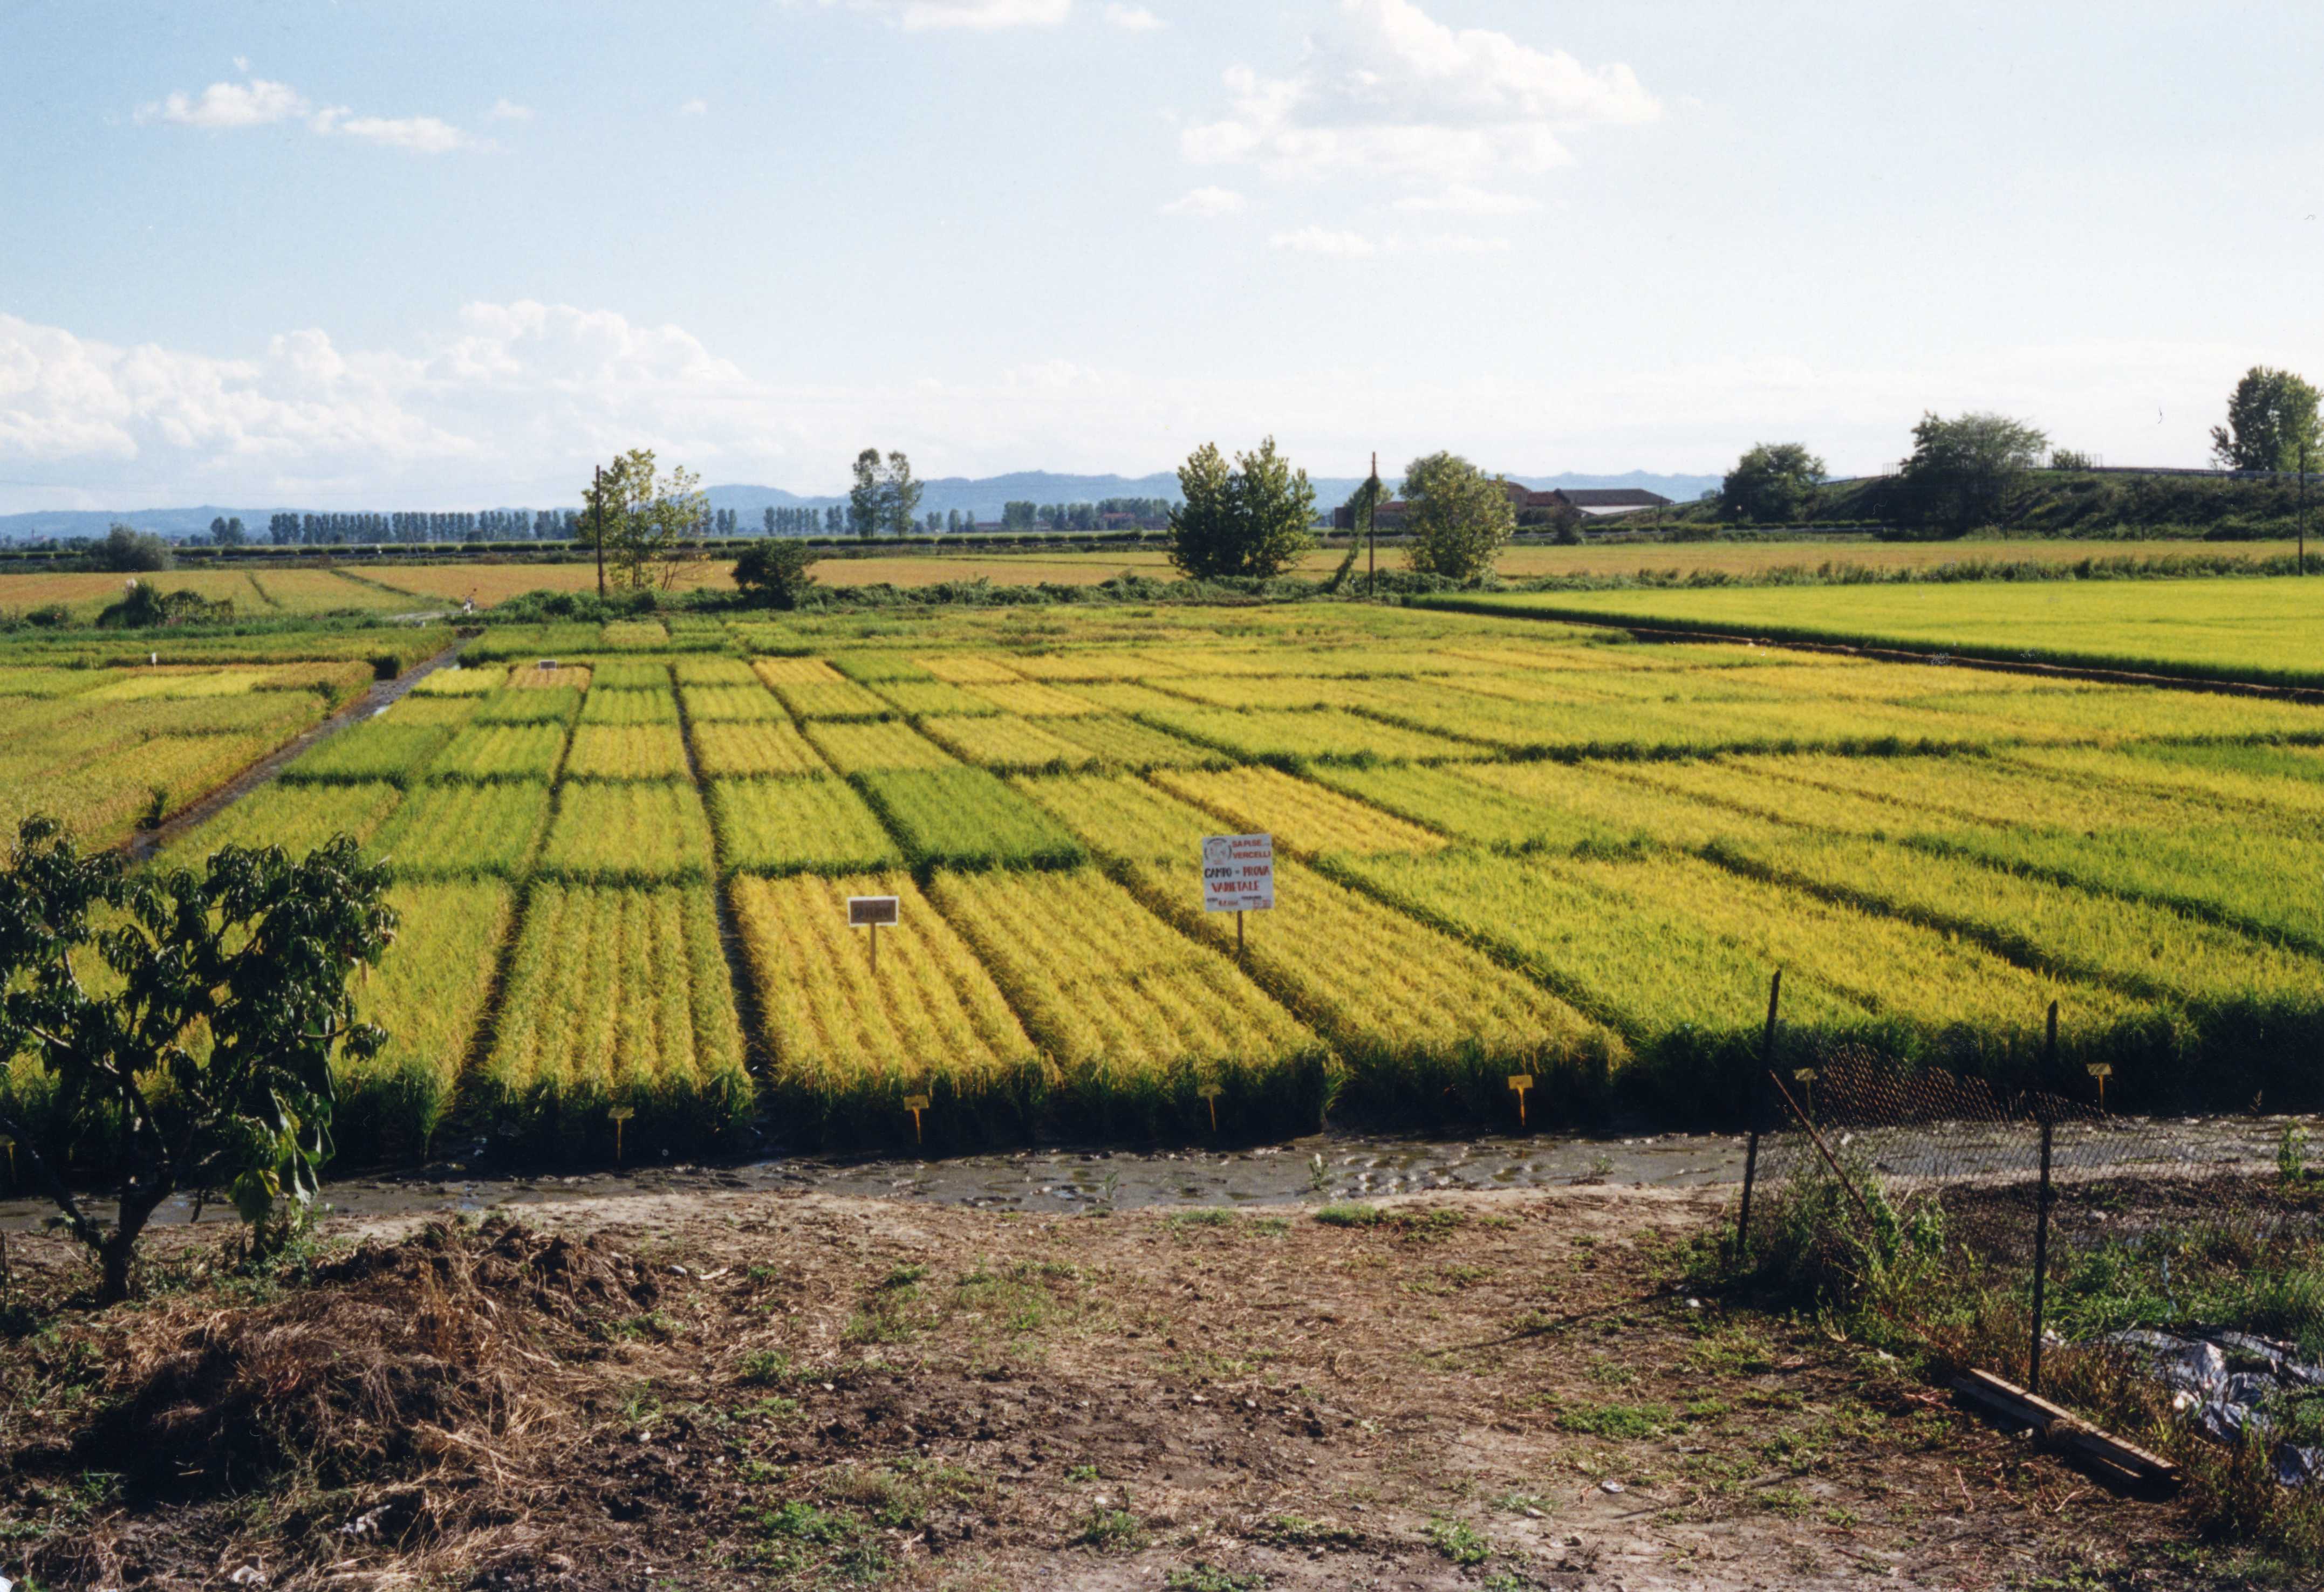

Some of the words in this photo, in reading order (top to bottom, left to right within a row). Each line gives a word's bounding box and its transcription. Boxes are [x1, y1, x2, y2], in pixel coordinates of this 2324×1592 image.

[1233, 850, 1271, 859] VERCELLI
[1205, 867, 1232, 879] CAMPO
[1242, 866, 1270, 876] PROVA
[1211, 881, 1259, 893] VARIETALE
